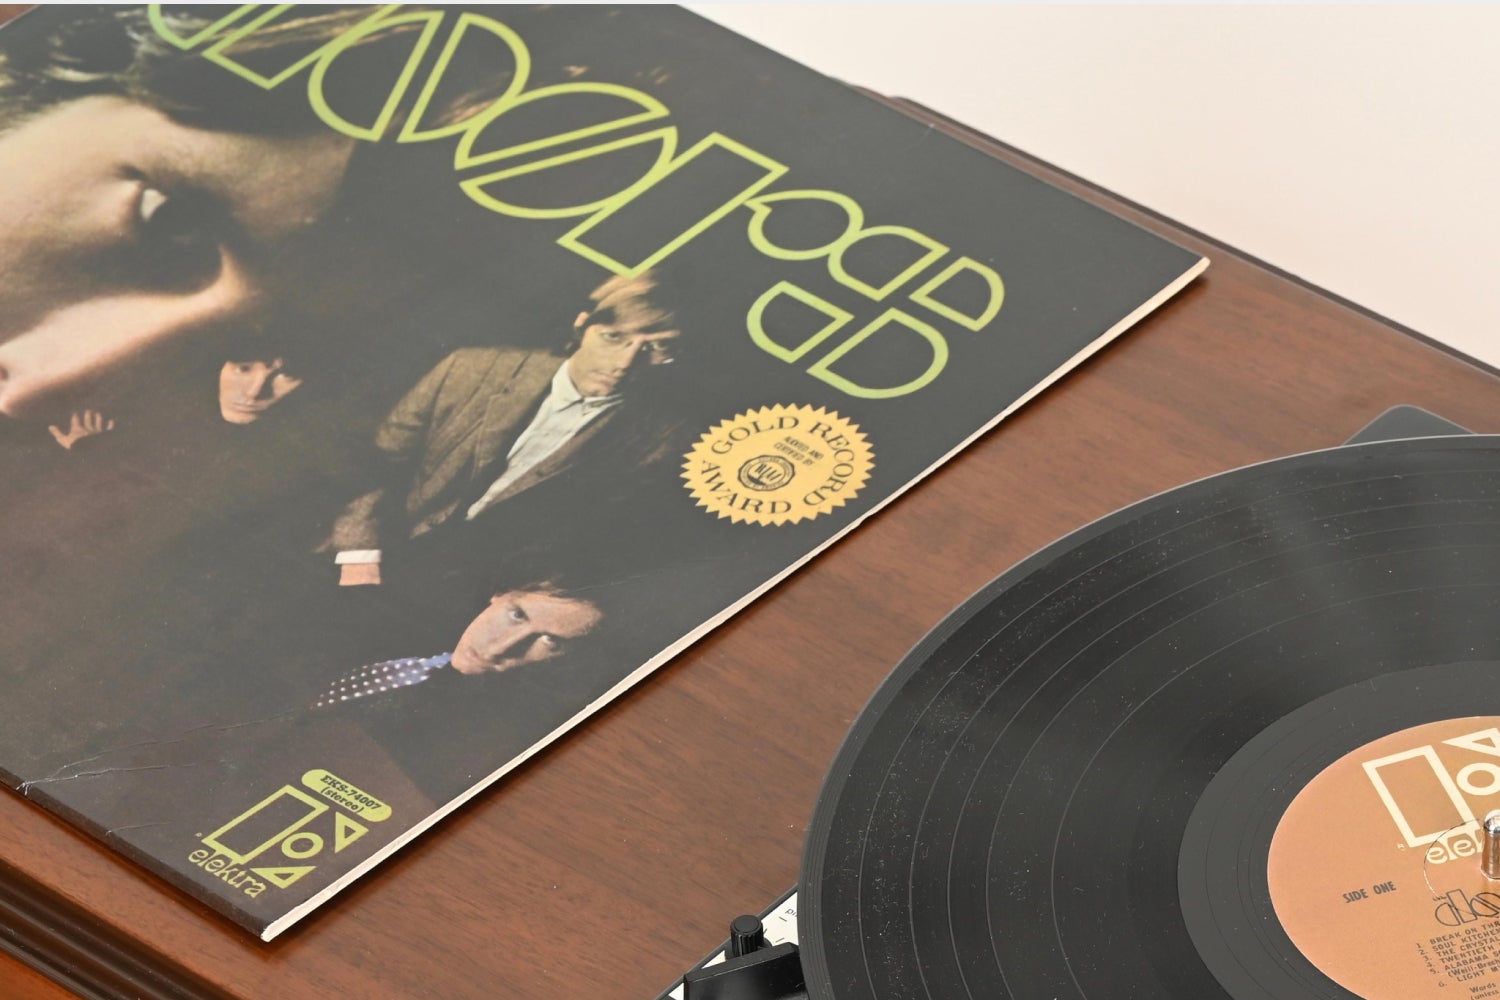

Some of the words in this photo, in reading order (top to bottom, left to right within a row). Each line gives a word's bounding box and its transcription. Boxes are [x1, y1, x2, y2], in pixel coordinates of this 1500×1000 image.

[711, 415, 799, 455] GOLD
[803, 421, 855, 506] RECORD
[701, 460, 792, 514] AWARD
[319, 774, 382, 811] EKS-74007
[320, 786, 365, 814] (stereo)
[188, 848, 267, 898] elektra
[1342, 889, 1368, 904] SIDE
[1373, 881, 1397, 896] ONE
[1429, 932, 1461, 945] BREAK
[1432, 941, 1456, 952] SOUL
[1436, 948, 1456, 957] THE
[1460, 936, 1500, 951] CRYSTAL
[1440, 945, 1495, 964] TWENTIETH
[1444, 954, 1489, 971] ALABAMA
[1456, 970, 1485, 982] LIGHT
[1469, 982, 1496, 994] Words
